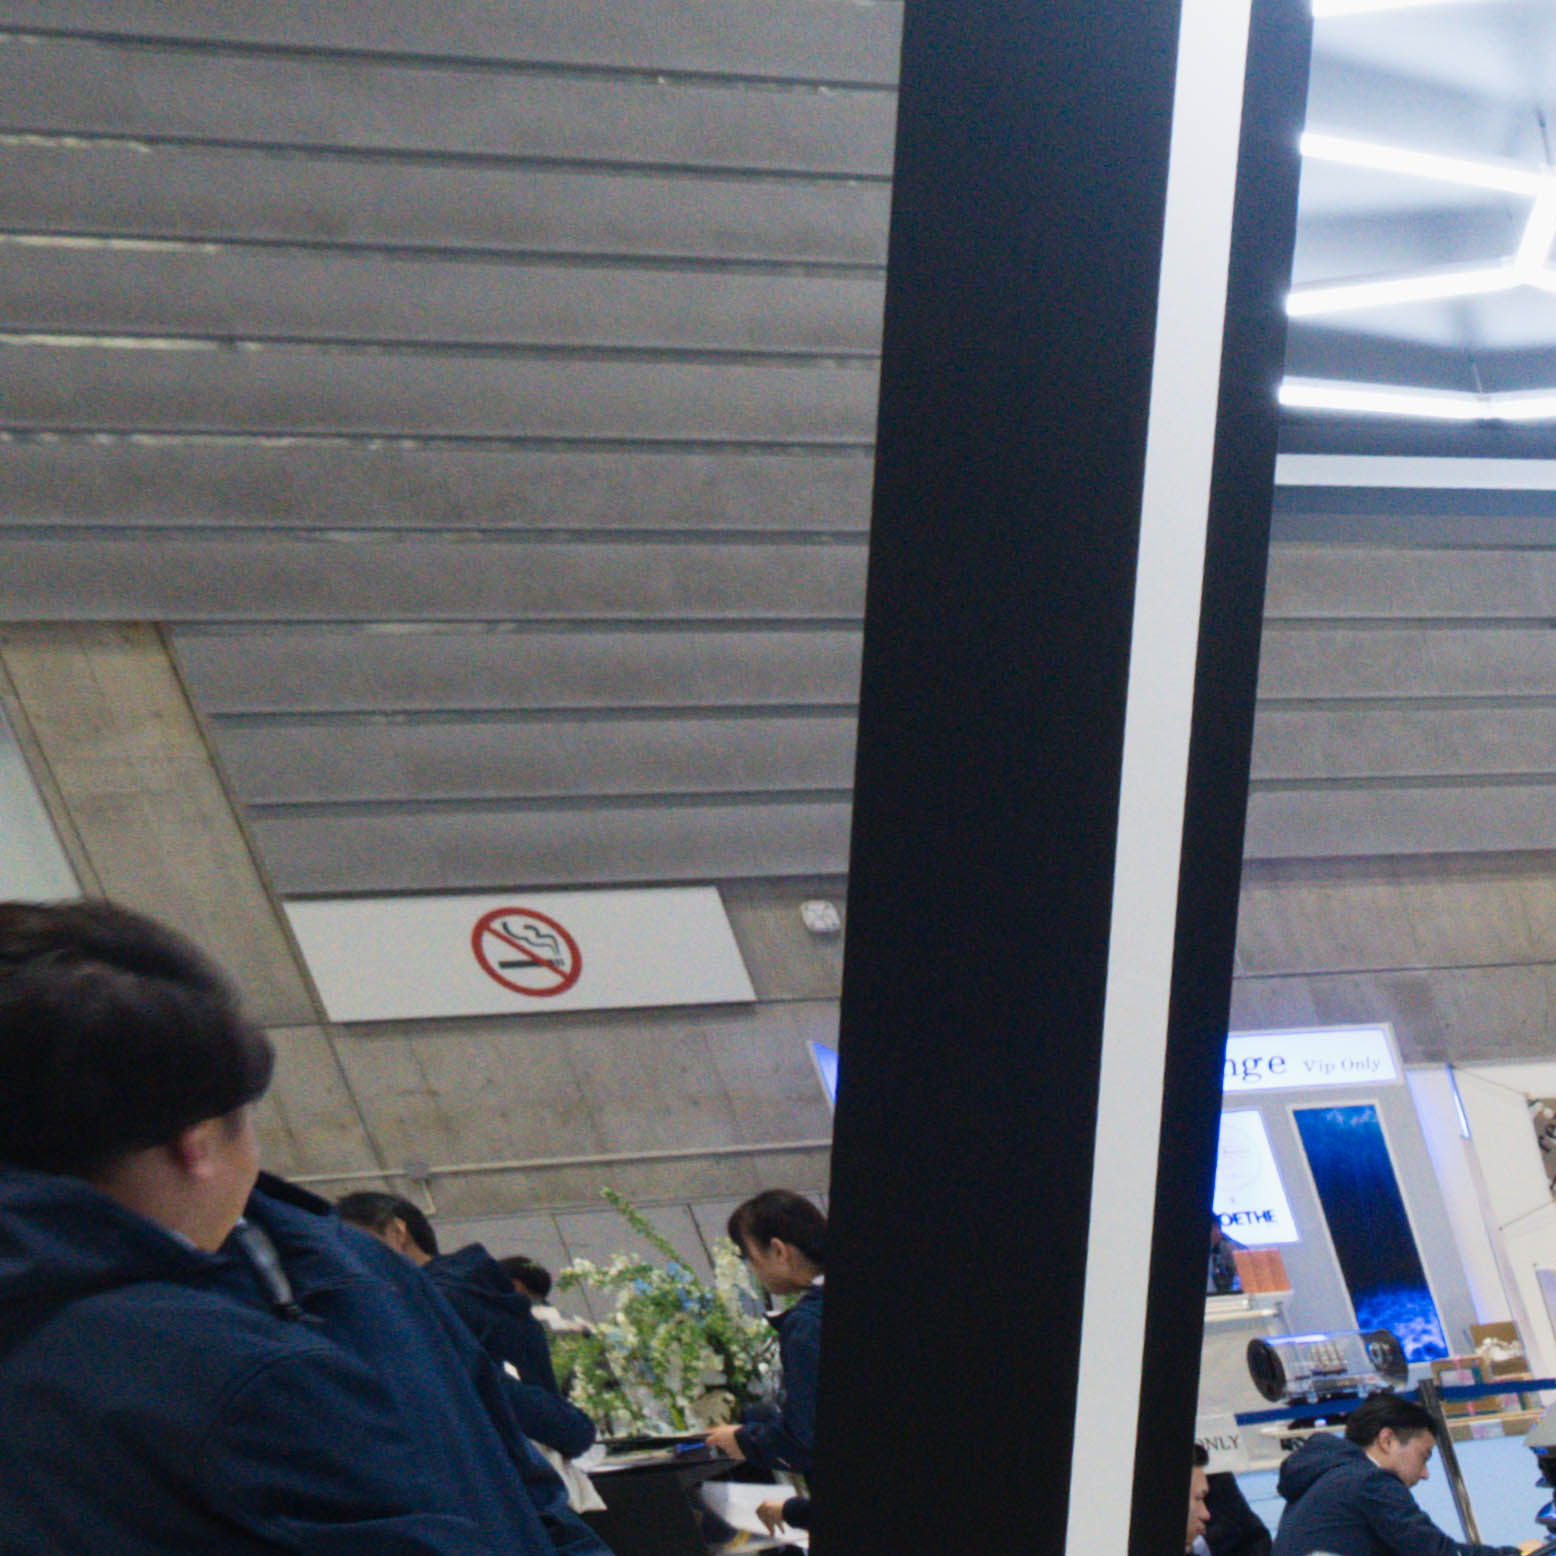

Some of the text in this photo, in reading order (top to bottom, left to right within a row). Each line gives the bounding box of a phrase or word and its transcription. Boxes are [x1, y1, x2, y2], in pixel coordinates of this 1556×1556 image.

[1224, 1054, 1382, 1084] nge Vip Only
[1219, 1209, 1277, 1226] OETHE
